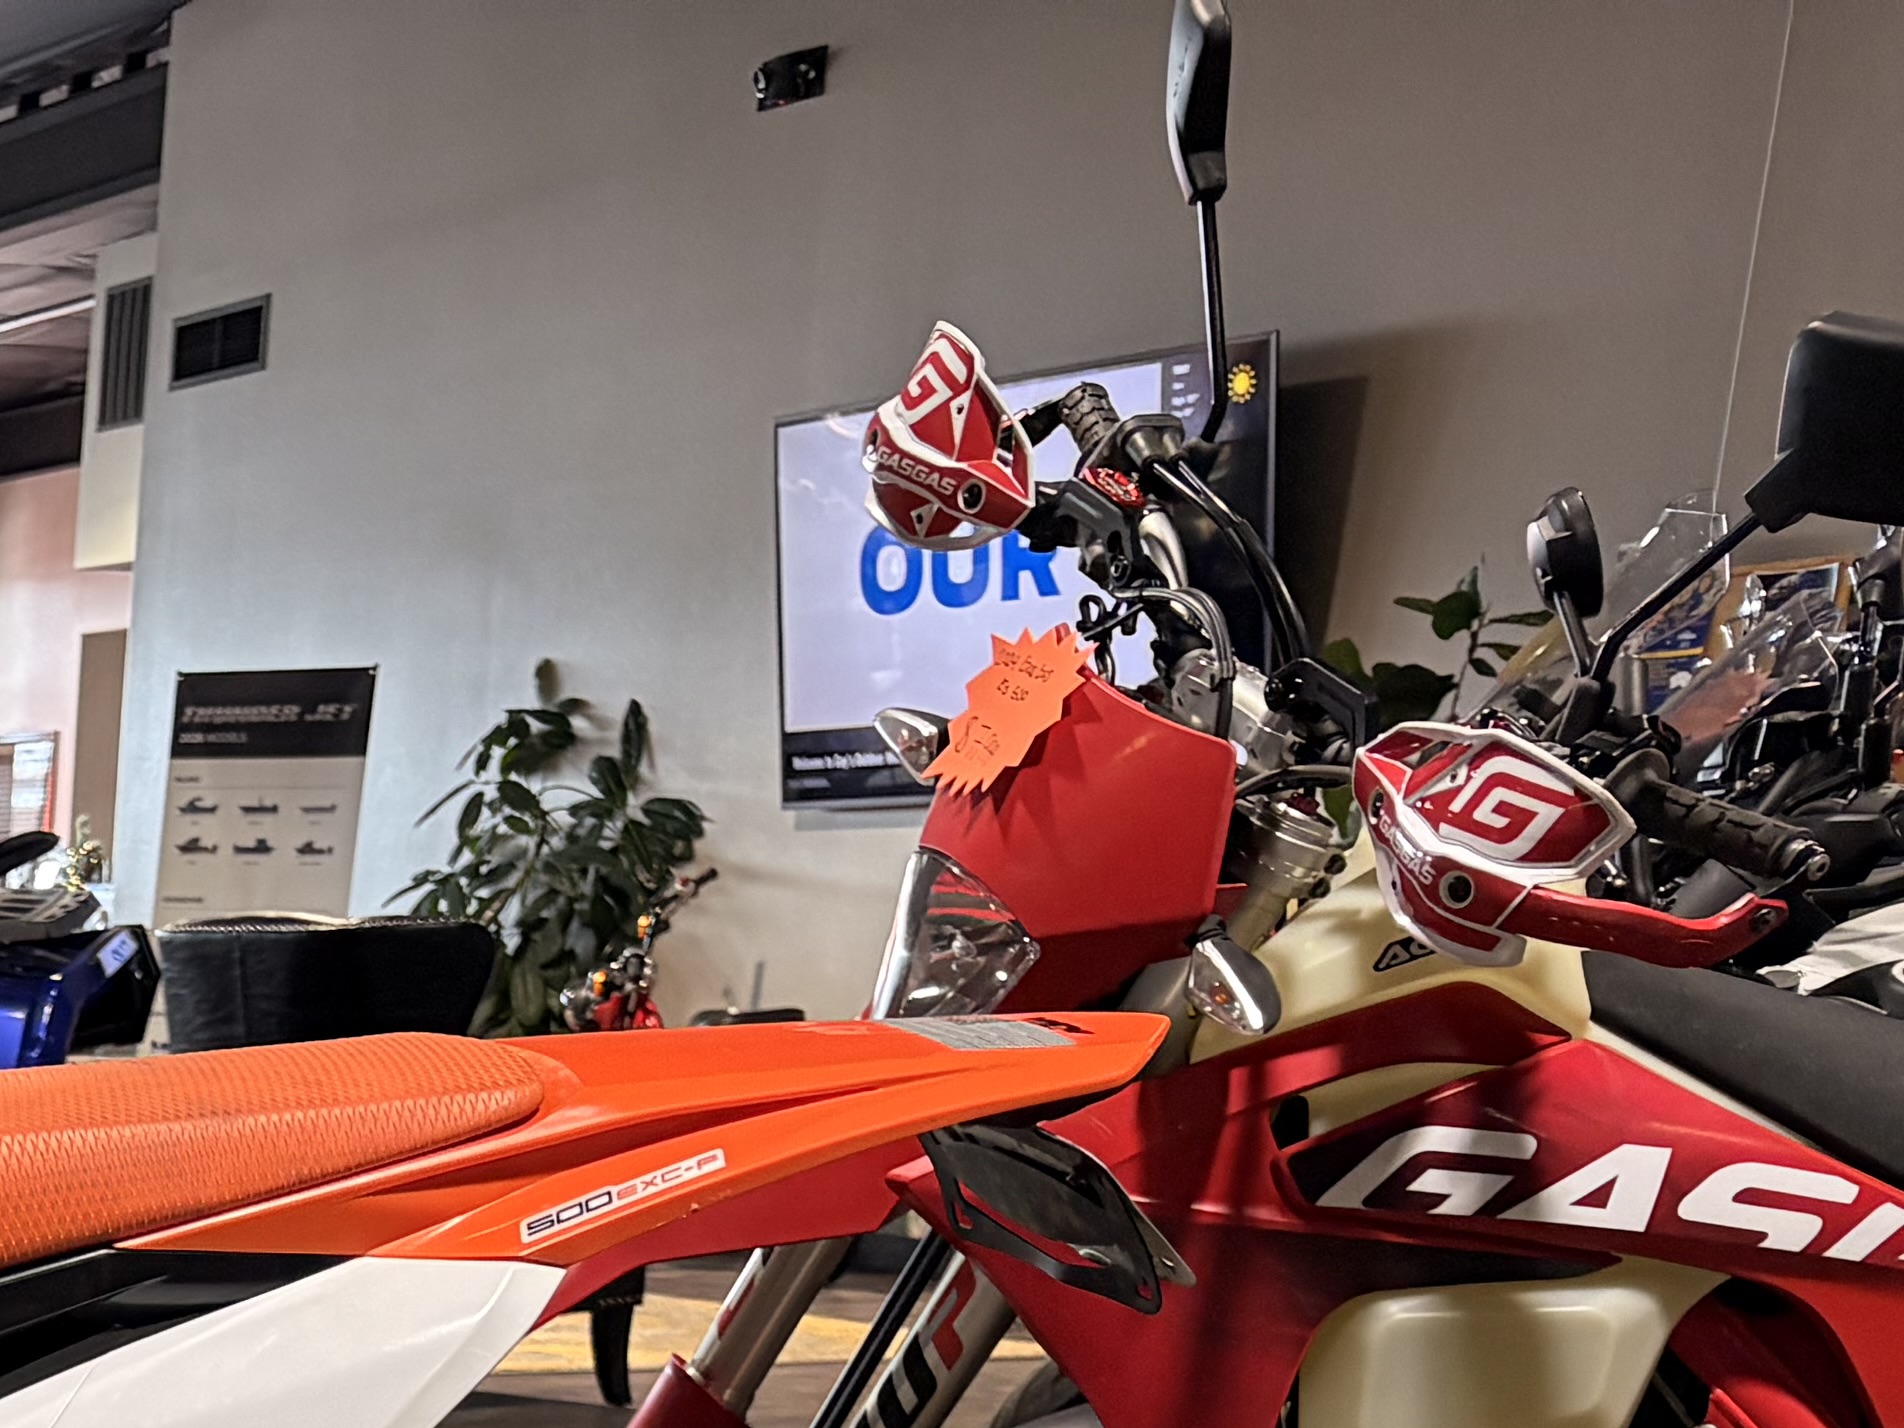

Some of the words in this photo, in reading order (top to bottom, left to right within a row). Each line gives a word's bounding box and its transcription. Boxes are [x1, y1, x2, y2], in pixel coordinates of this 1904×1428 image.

[877, 448, 958, 496] GASGAS
[861, 525, 1061, 615] OUR
[1315, 1125, 1904, 1262] GAS
